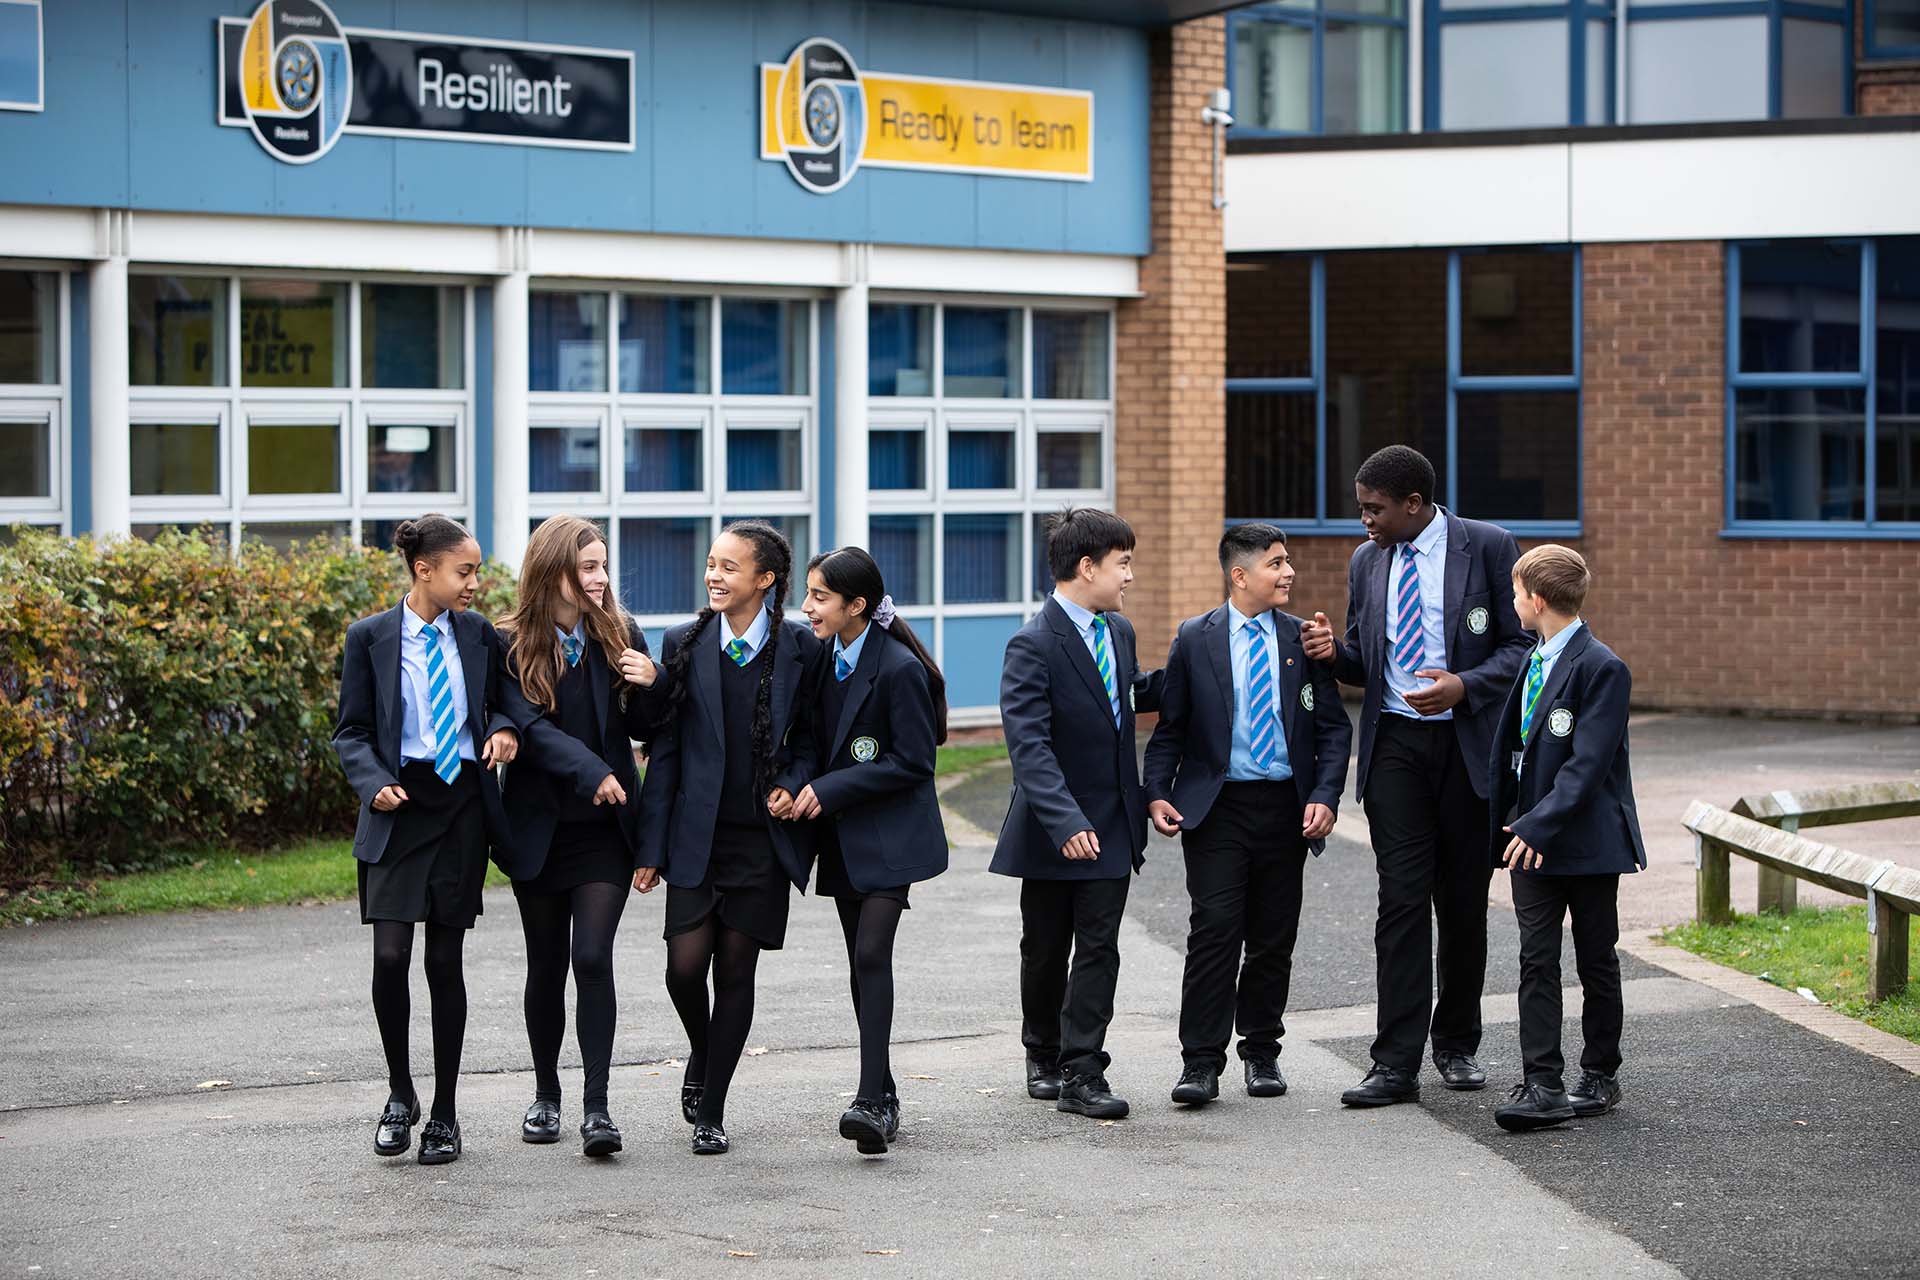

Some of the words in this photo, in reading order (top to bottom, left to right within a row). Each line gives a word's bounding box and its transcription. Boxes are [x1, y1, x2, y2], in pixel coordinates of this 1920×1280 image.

[418, 57, 572, 117] Resilient
[880, 98, 963, 152] Ready
[974, 112, 1001, 145] to
[1011, 110, 1075, 151] learn
[241, 311, 287, 342] EAL
[193, 342, 315, 375] PJECT
